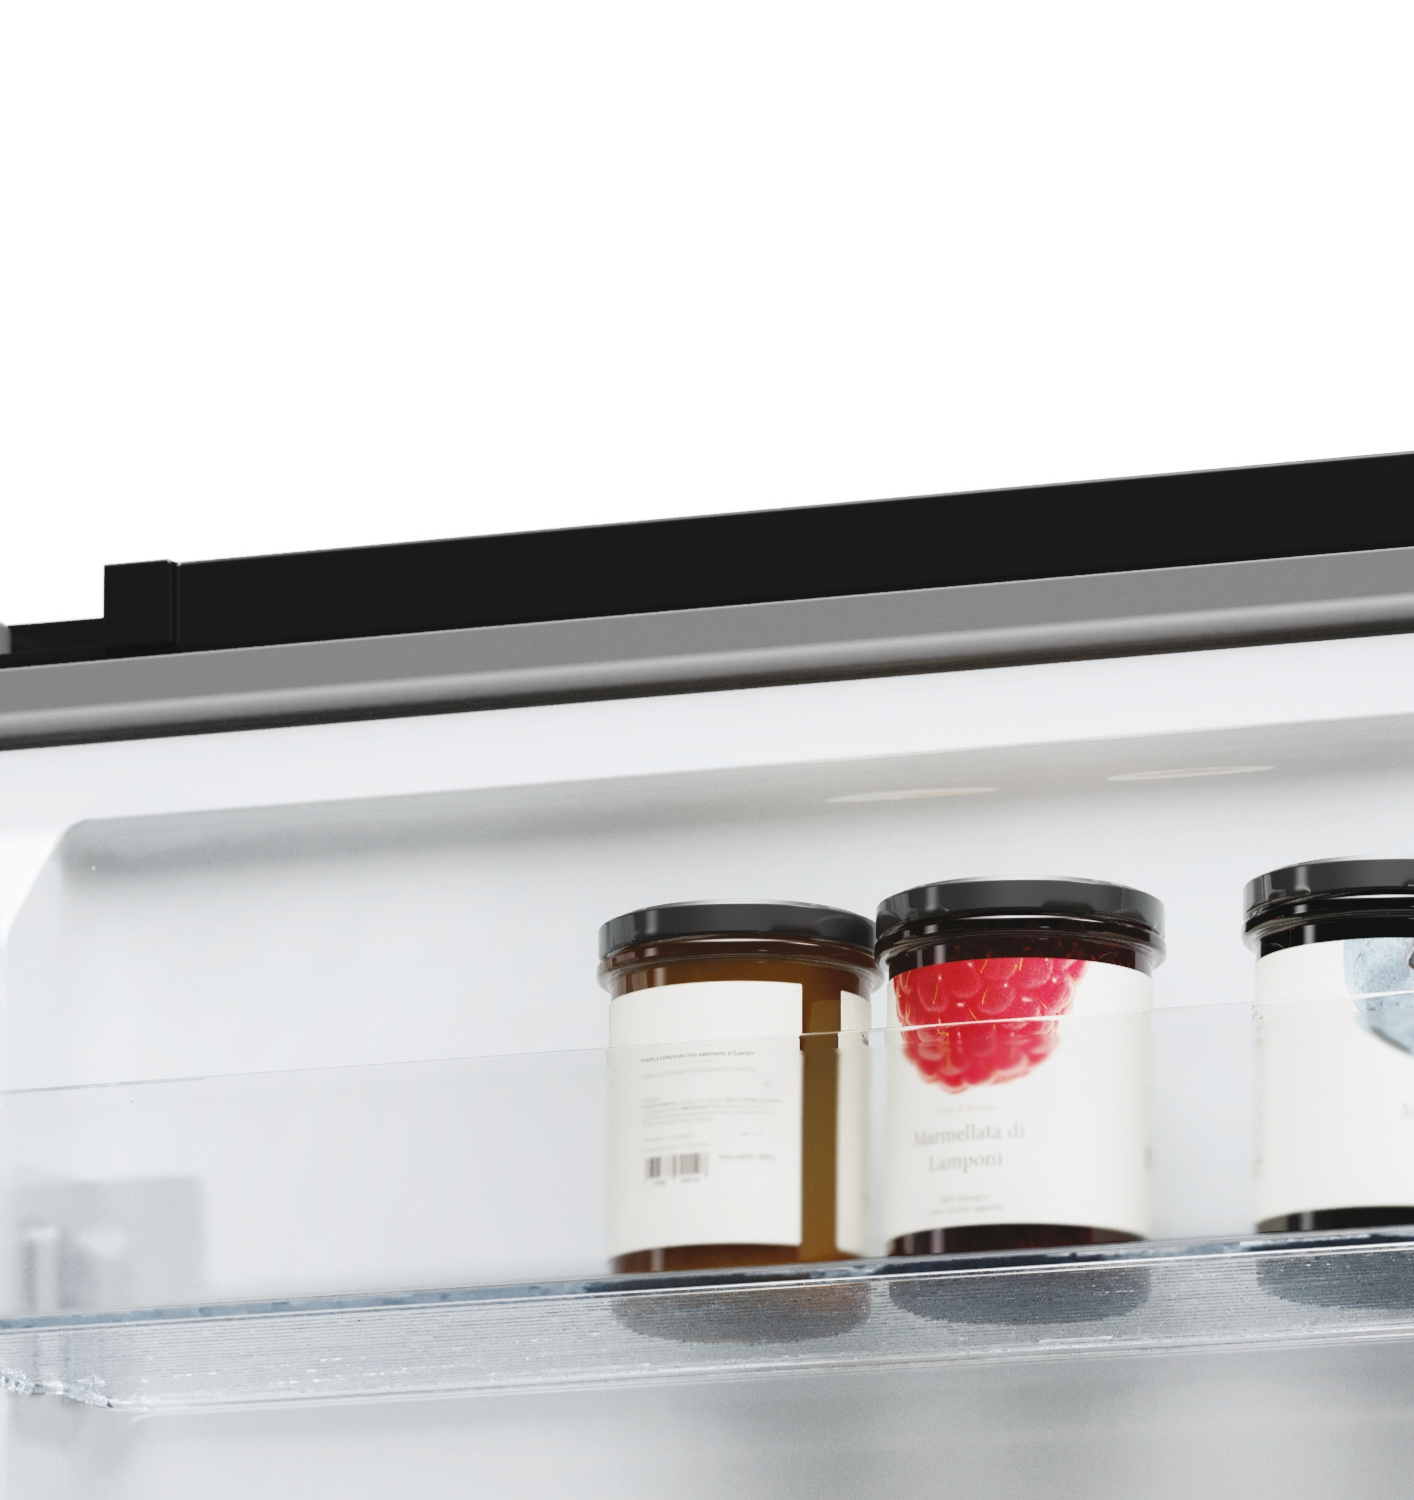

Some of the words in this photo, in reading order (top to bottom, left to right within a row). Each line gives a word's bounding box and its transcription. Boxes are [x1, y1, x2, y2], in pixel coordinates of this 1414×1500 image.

[913, 1123, 1002, 1147] Marmellata
[1007, 1121, 1025, 1140] di
[929, 1150, 1003, 1174] Lamponi
